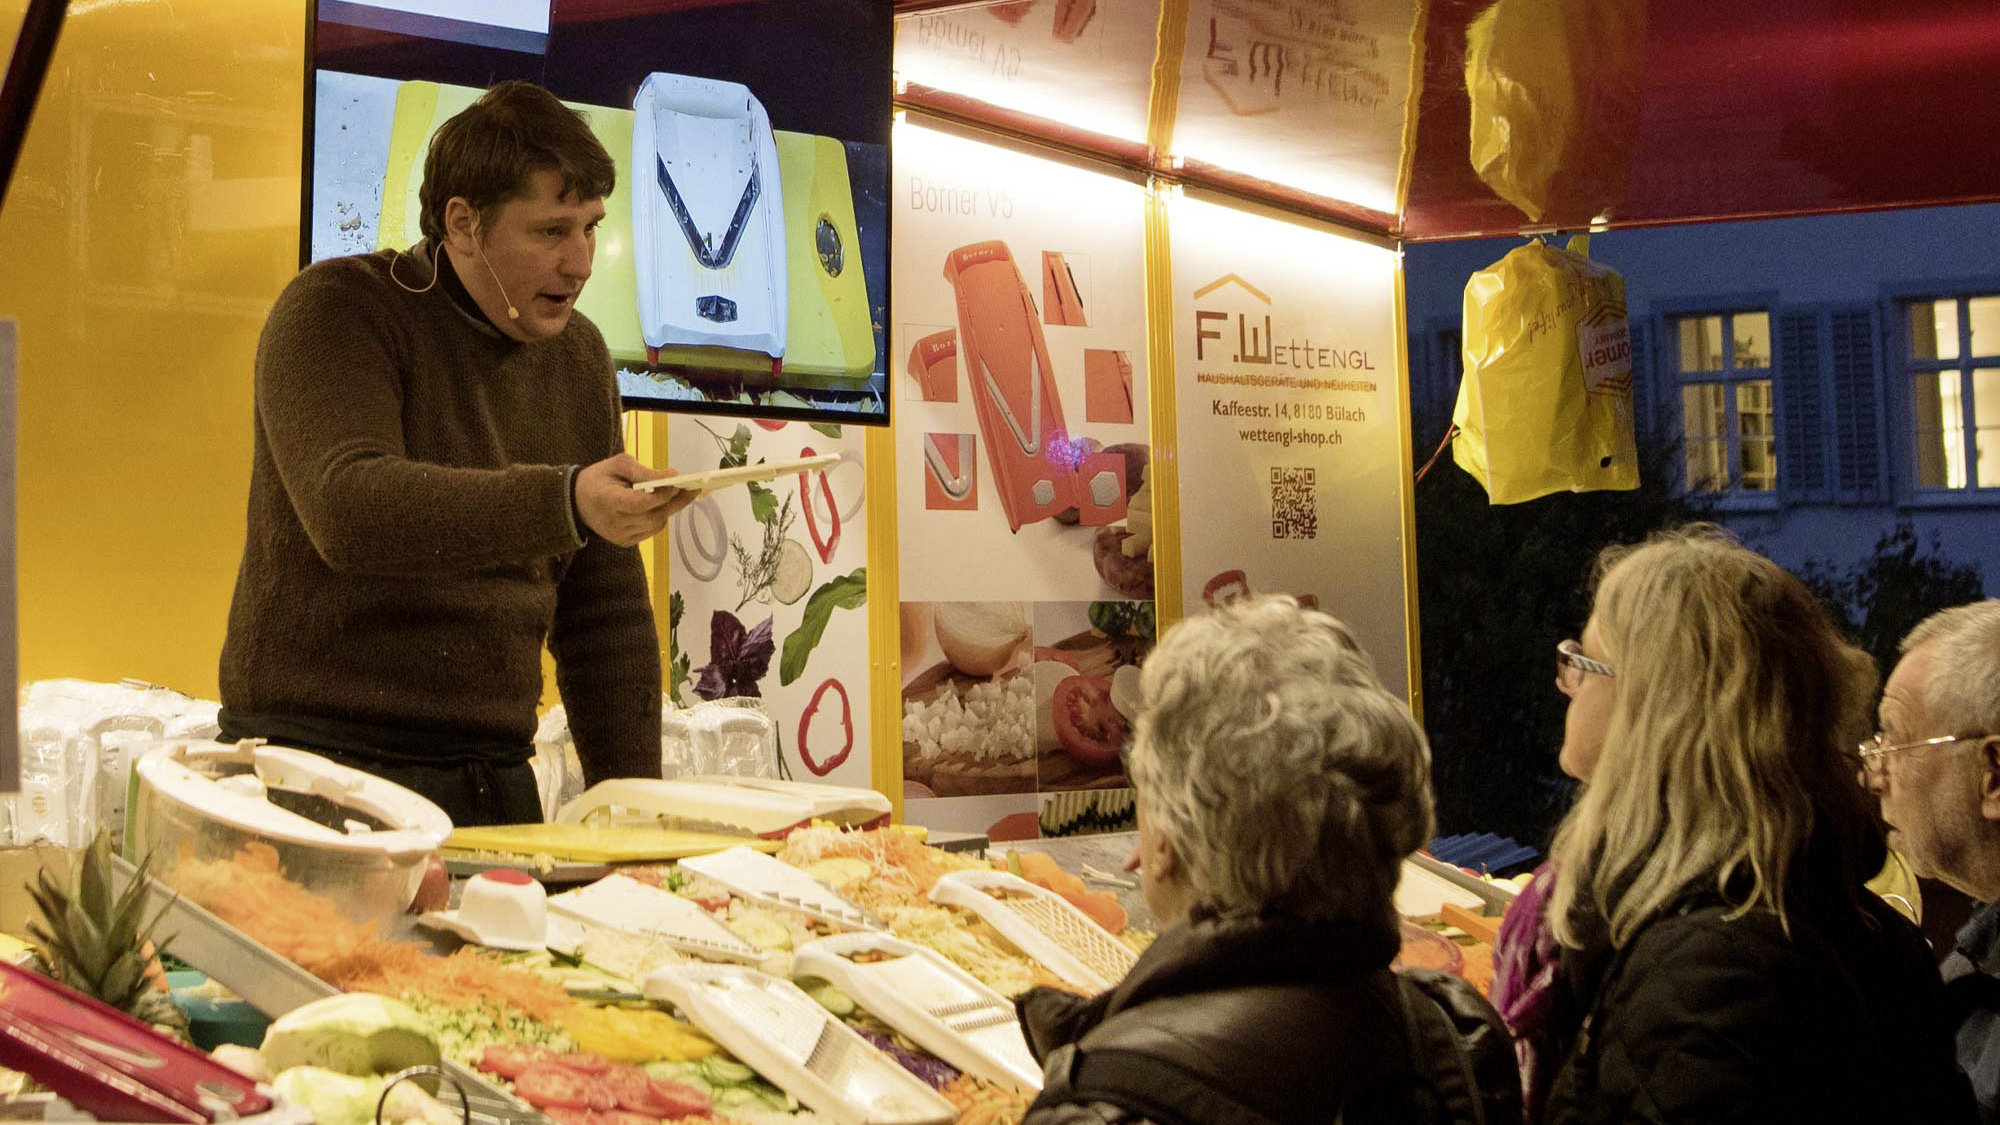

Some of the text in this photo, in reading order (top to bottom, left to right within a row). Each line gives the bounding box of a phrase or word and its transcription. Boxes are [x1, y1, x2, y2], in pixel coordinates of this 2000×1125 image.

[1197, 372, 1377, 393] HAUSHALTSGERÄTE UND NEUHEITEN
[1212, 399, 1366, 422] Kaffeestr. 14, 8180 Bülach
[1239, 428, 1343, 448] wettengl-shop.ch
